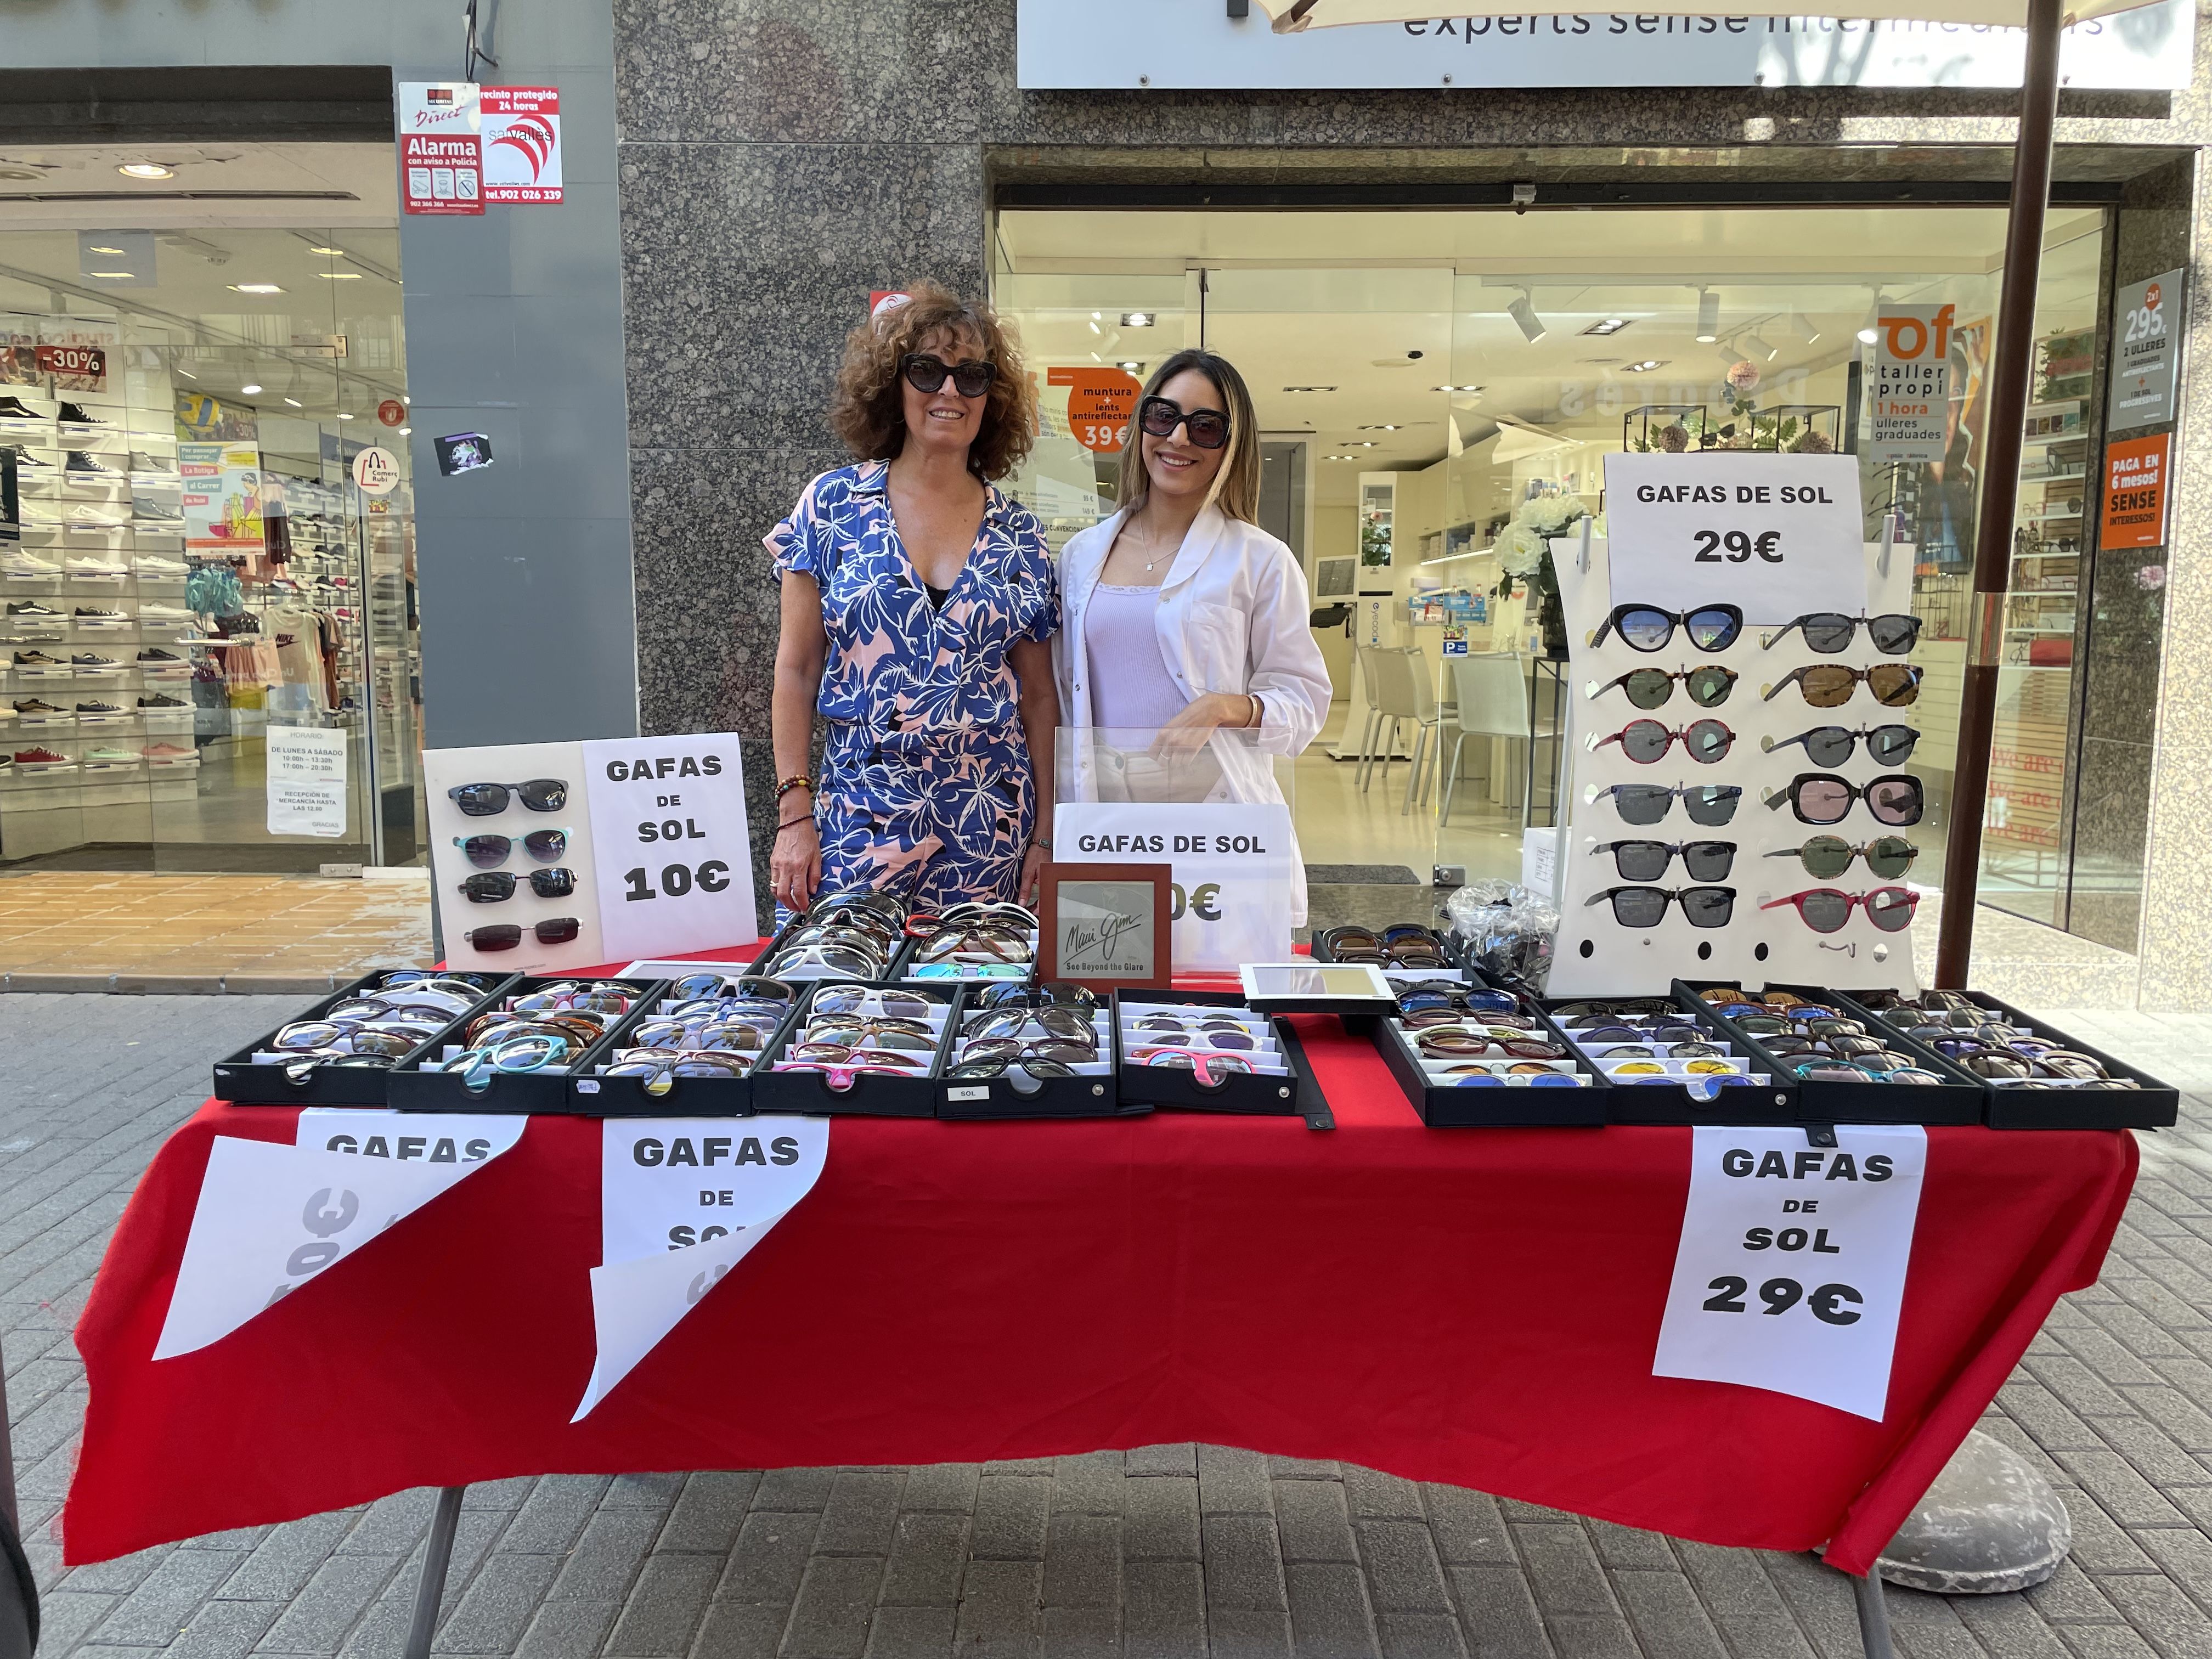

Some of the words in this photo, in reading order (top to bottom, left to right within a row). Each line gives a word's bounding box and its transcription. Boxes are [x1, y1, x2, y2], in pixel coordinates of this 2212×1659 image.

[481, 90, 511, 99] recinto
[514, 91, 557, 100] protegido
[499, 102, 511, 110] 24
[514, 101, 539, 111] horas
[414, 105, 469, 128] Direct
[489, 127, 552, 141] satvallès
[408, 137, 476, 156] Alarma
[424, 157, 443, 165] aviso
[522, 190, 541, 199] 026
[544, 190, 561, 200] 339
[2147, 290, 2158, 302] 2x1
[2124, 347, 2129, 357] 2
[2131, 338, 2166, 355] ULLERES
[43, 349, 99, 371] -30%
[1881, 364, 1944, 379] taller
[1084, 388, 1132, 396] muntura
[1879, 380, 1942, 398] propi
[1096, 403, 1119, 411] lents
[1877, 402, 1883, 414] 1
[1890, 401, 1928, 414] hora
[1876, 418, 1917, 428] ulleres
[1875, 429, 1940, 441] graduades
[2113, 457, 2140, 473] PAGA
[2145, 454, 2159, 468] EN
[373, 470, 398, 478] Comerç
[2112, 475, 2118, 489] 6
[2121, 469, 2158, 489] mesos!
[1637, 485, 1727, 504] GAFAS
[1736, 486, 1771, 504] DE
[1780, 486, 1833, 504] SOL
[2111, 490, 2157, 512] SENSE
[2109, 512, 2155, 527] INTERESSOS!
[1694, 529, 1784, 563] 29€
[275, 634, 295, 642] NIKE
[1446, 642, 1455, 653] P
[1992, 746, 2018, 768] We
[2023, 755, 2053, 772] are
[606, 755, 723, 782] GAFAS
[657, 794, 681, 807] DE
[2021, 792, 2051, 809] are
[638, 817, 707, 843] SOL
[2018, 825, 2049, 845] are
[1078, 834, 1164, 853] GAFAS
[1174, 836, 1206, 853] DE
[1215, 836, 1266, 854] SOL
[624, 860, 731, 902] 10€
[1171, 882, 1222, 922] 0€
[1066, 924, 1097, 953] Maui
[1082, 963, 1108, 972] Beyond
[327, 1134, 491, 1164] GAFAS
[633, 1137, 799, 1167] GAFAS
[1722, 1148, 1894, 1183] GAFAS
[699, 1190, 733, 1206] DE
[1782, 1200, 1819, 1214] DE
[1742, 1228, 1841, 1255] SOL
[1702, 1275, 1863, 1326] 29€
